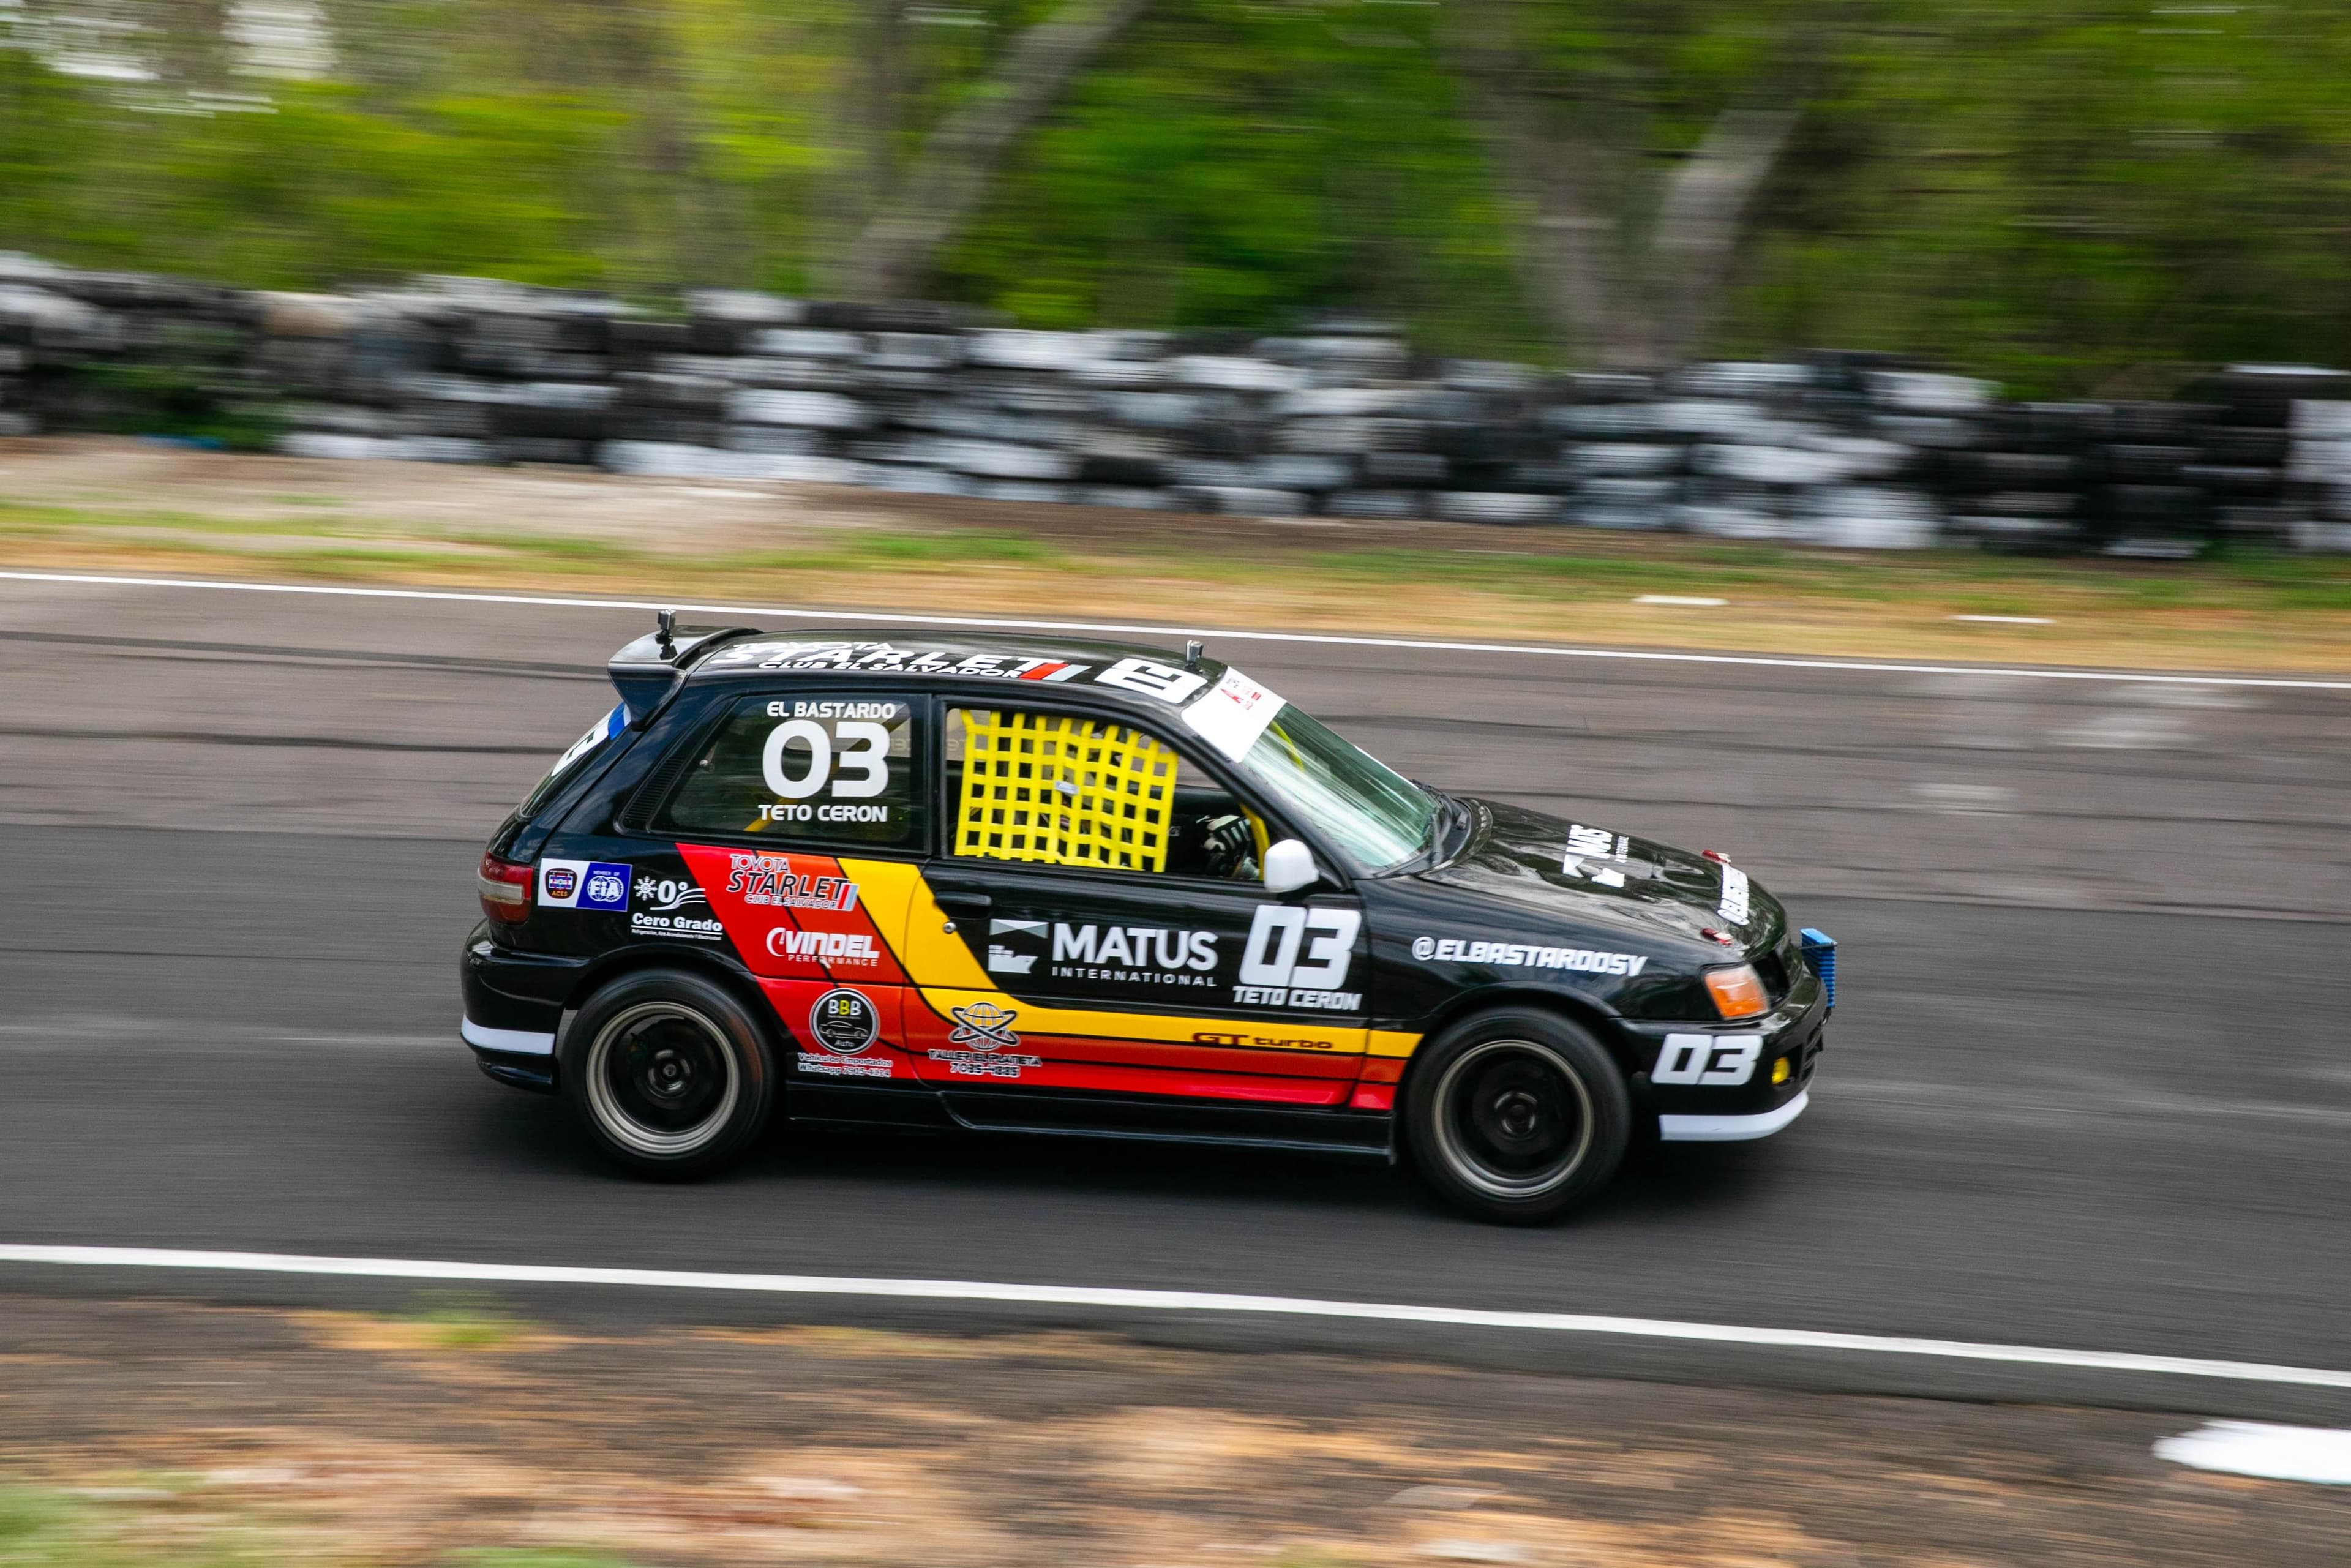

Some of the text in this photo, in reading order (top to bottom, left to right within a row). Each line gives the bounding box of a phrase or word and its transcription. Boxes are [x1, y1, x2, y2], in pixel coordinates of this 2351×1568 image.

[733, 642, 893, 651] TOYOTA
[710, 648, 1064, 671] STARLET
[759, 661, 829, 670] CLUB
[864, 663, 1021, 678] SALVADOR
[767, 702, 896, 719] EL BASTARDO
[762, 719, 891, 799] 03
[758, 804, 888, 823] TETO CERON
[730, 854, 790, 872] TOYOTA
[726, 871, 850, 900] STARLET
[744, 894, 838, 910] CLUB EL SALVADOR
[632, 912, 723, 931] Cero Grado
[1052, 923, 1218, 971] MATUS
[1239, 904, 1361, 990] 03
[1411, 936, 1648, 977] @ELBASTARDOSV
[1052, 966, 1218, 987] INTERNATIONAL
[828, 999, 861, 1015] BBB
[1232, 985, 1362, 1011] TETO CERON
[1192, 1032, 1332, 1049] GT turbo
[798, 1062, 842, 1076] Whatsapp
[1651, 1034, 1763, 1086] 03
